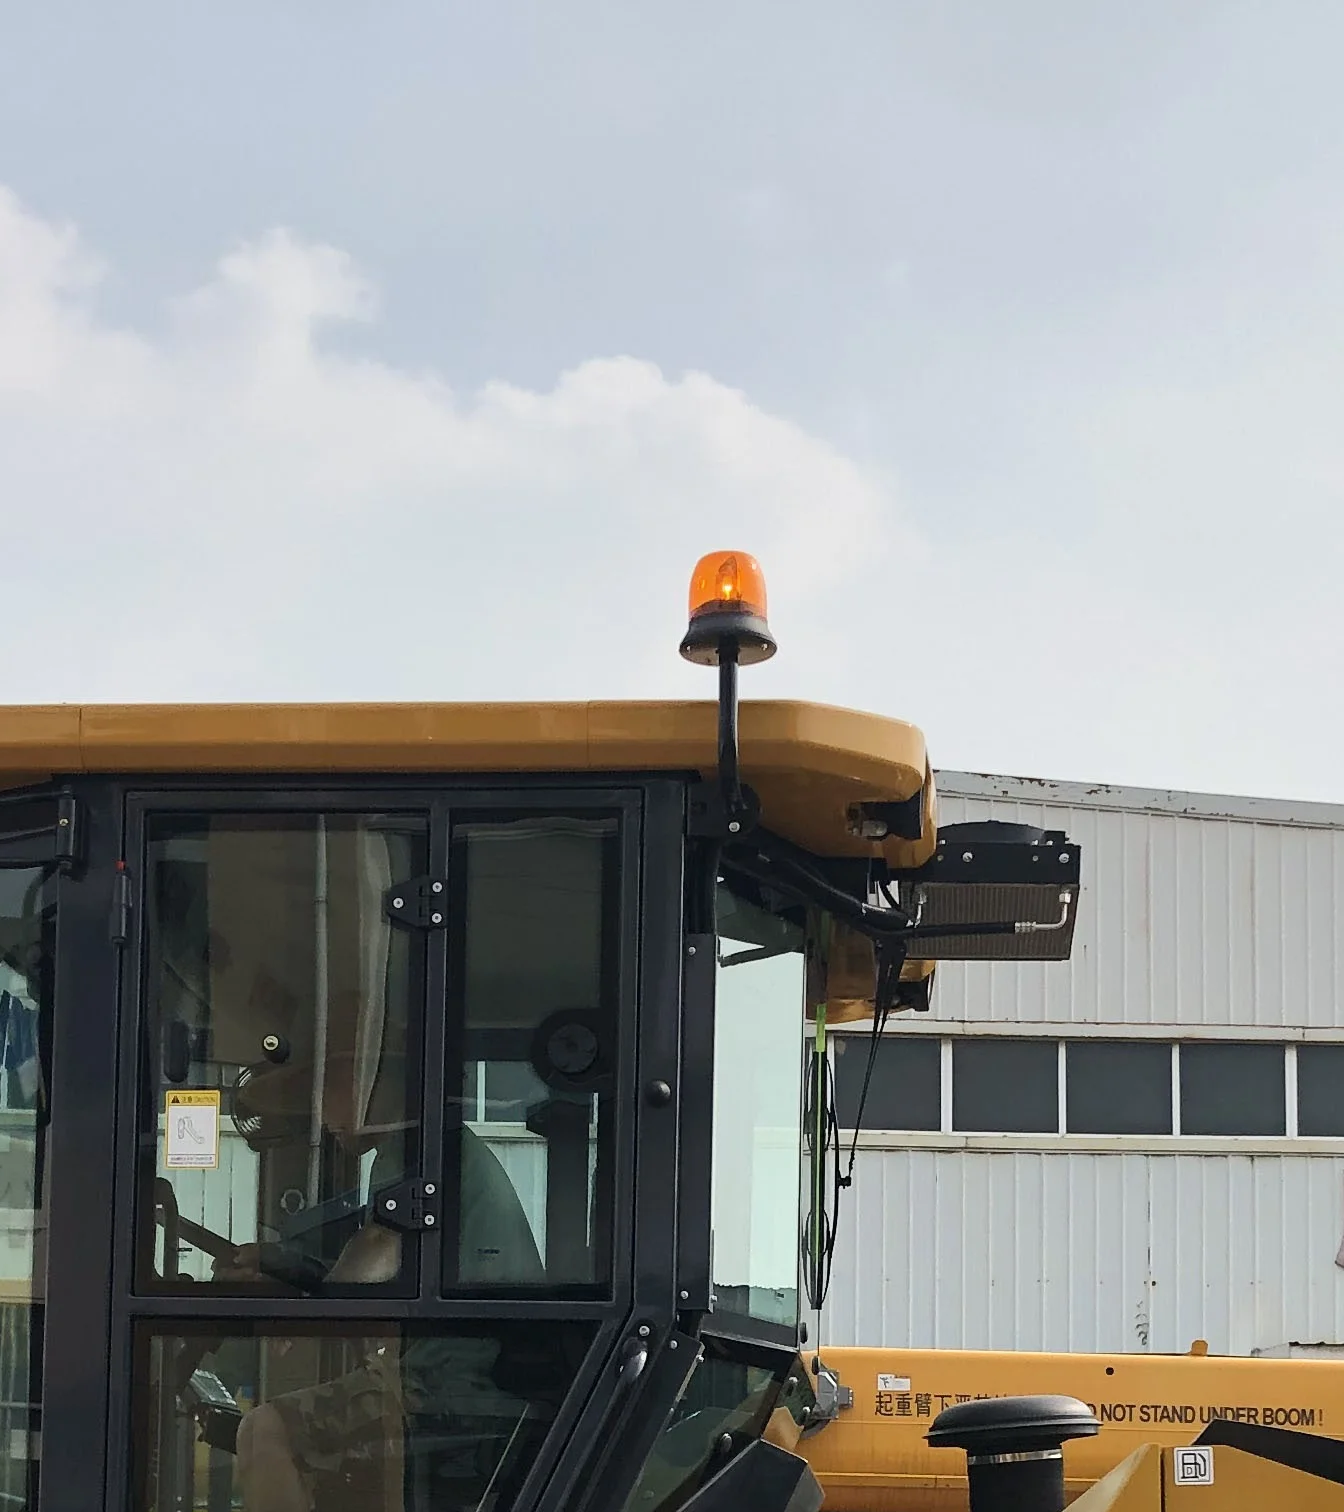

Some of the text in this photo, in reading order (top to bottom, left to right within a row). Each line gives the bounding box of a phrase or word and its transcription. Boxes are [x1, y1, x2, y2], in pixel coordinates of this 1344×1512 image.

[1100, 1403, 1136, 1422] NOT
[1139, 1404, 1196, 1423] STAND
[1199, 1405, 1259, 1425] UNDER
[1262, 1407, 1315, 1426] BOOM
